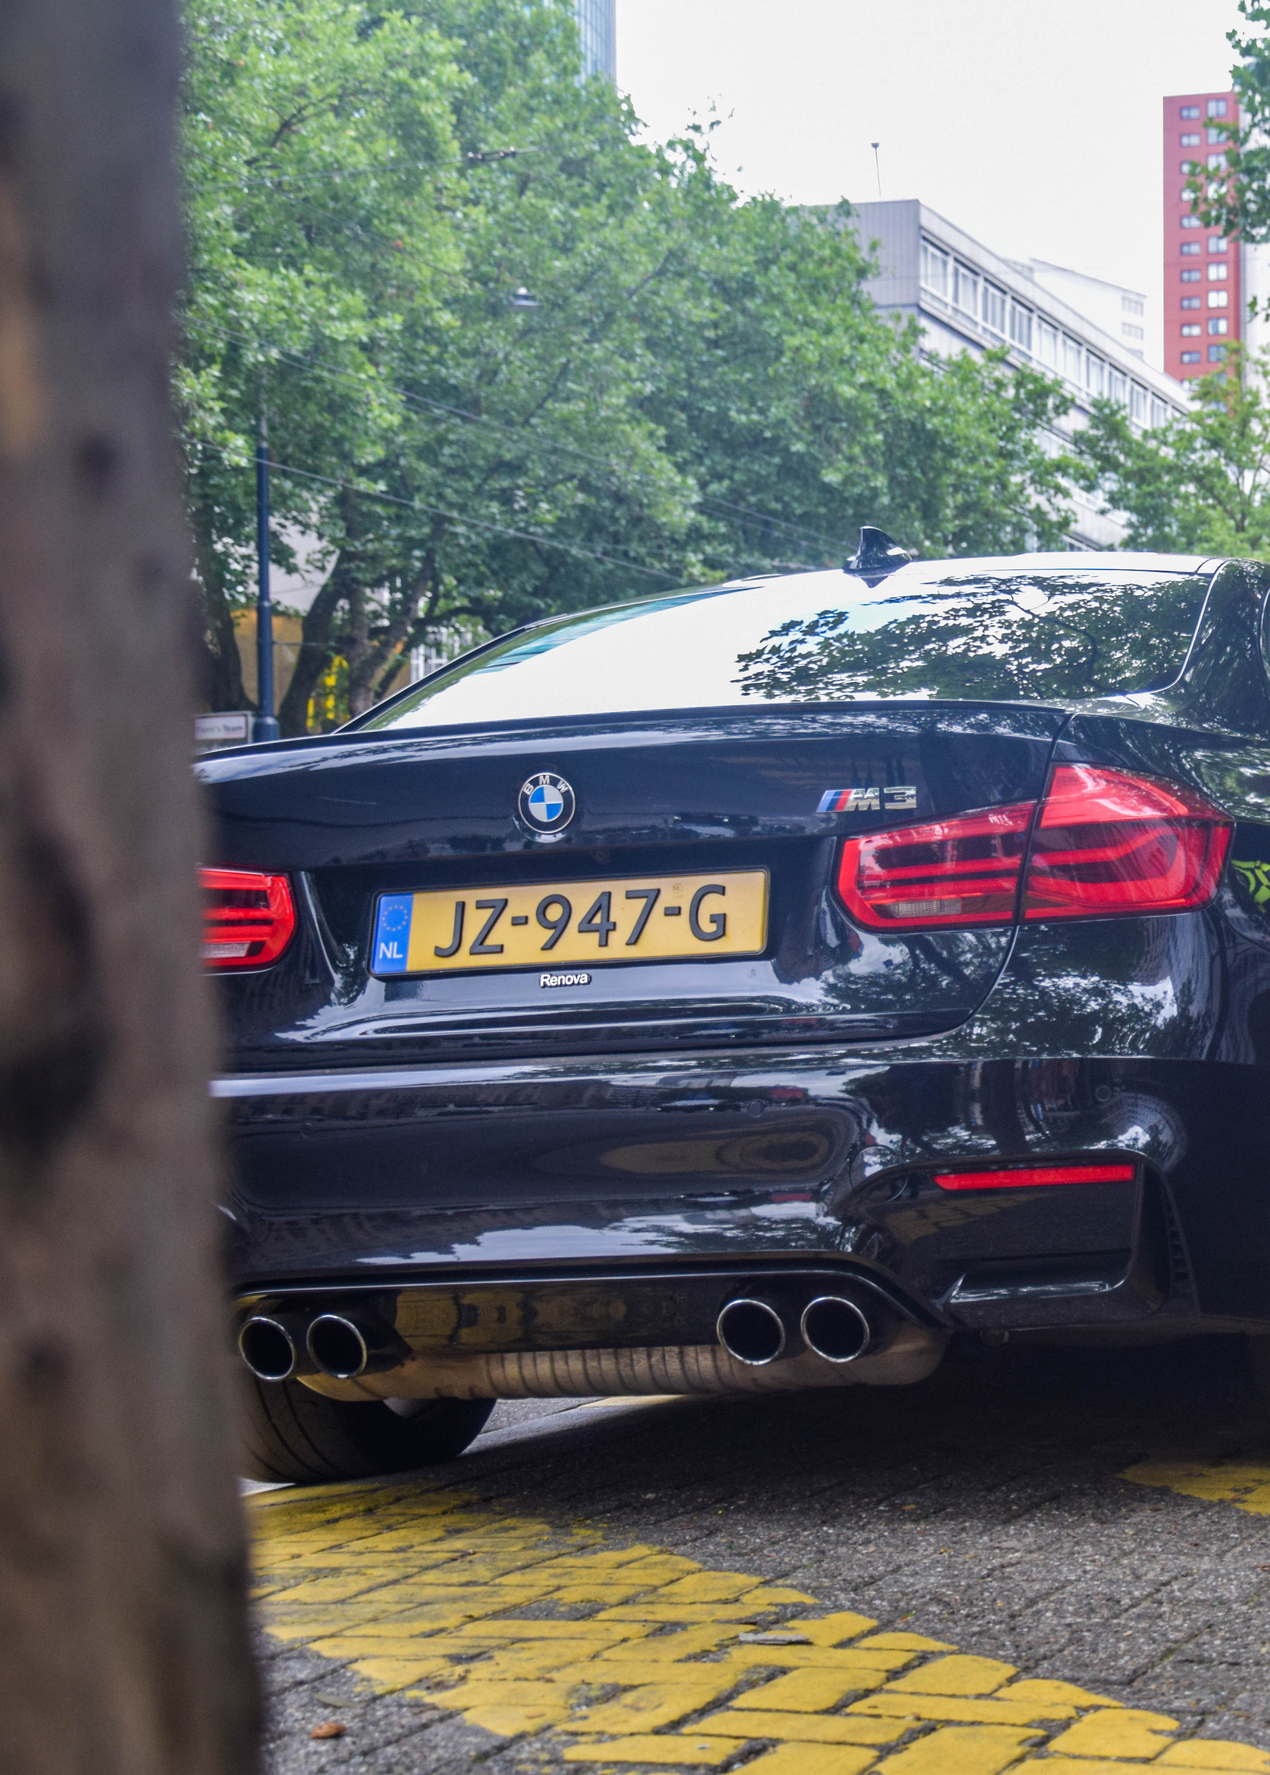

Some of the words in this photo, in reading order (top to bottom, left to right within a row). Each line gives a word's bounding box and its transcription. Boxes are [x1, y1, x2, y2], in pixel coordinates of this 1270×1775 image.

[523, 775, 569, 796] BMW
[843, 786, 918, 812] M3
[434, 884, 727, 958] JZ-947-G
[379, 942, 403, 960] NL
[540, 973, 589, 987] Renova
